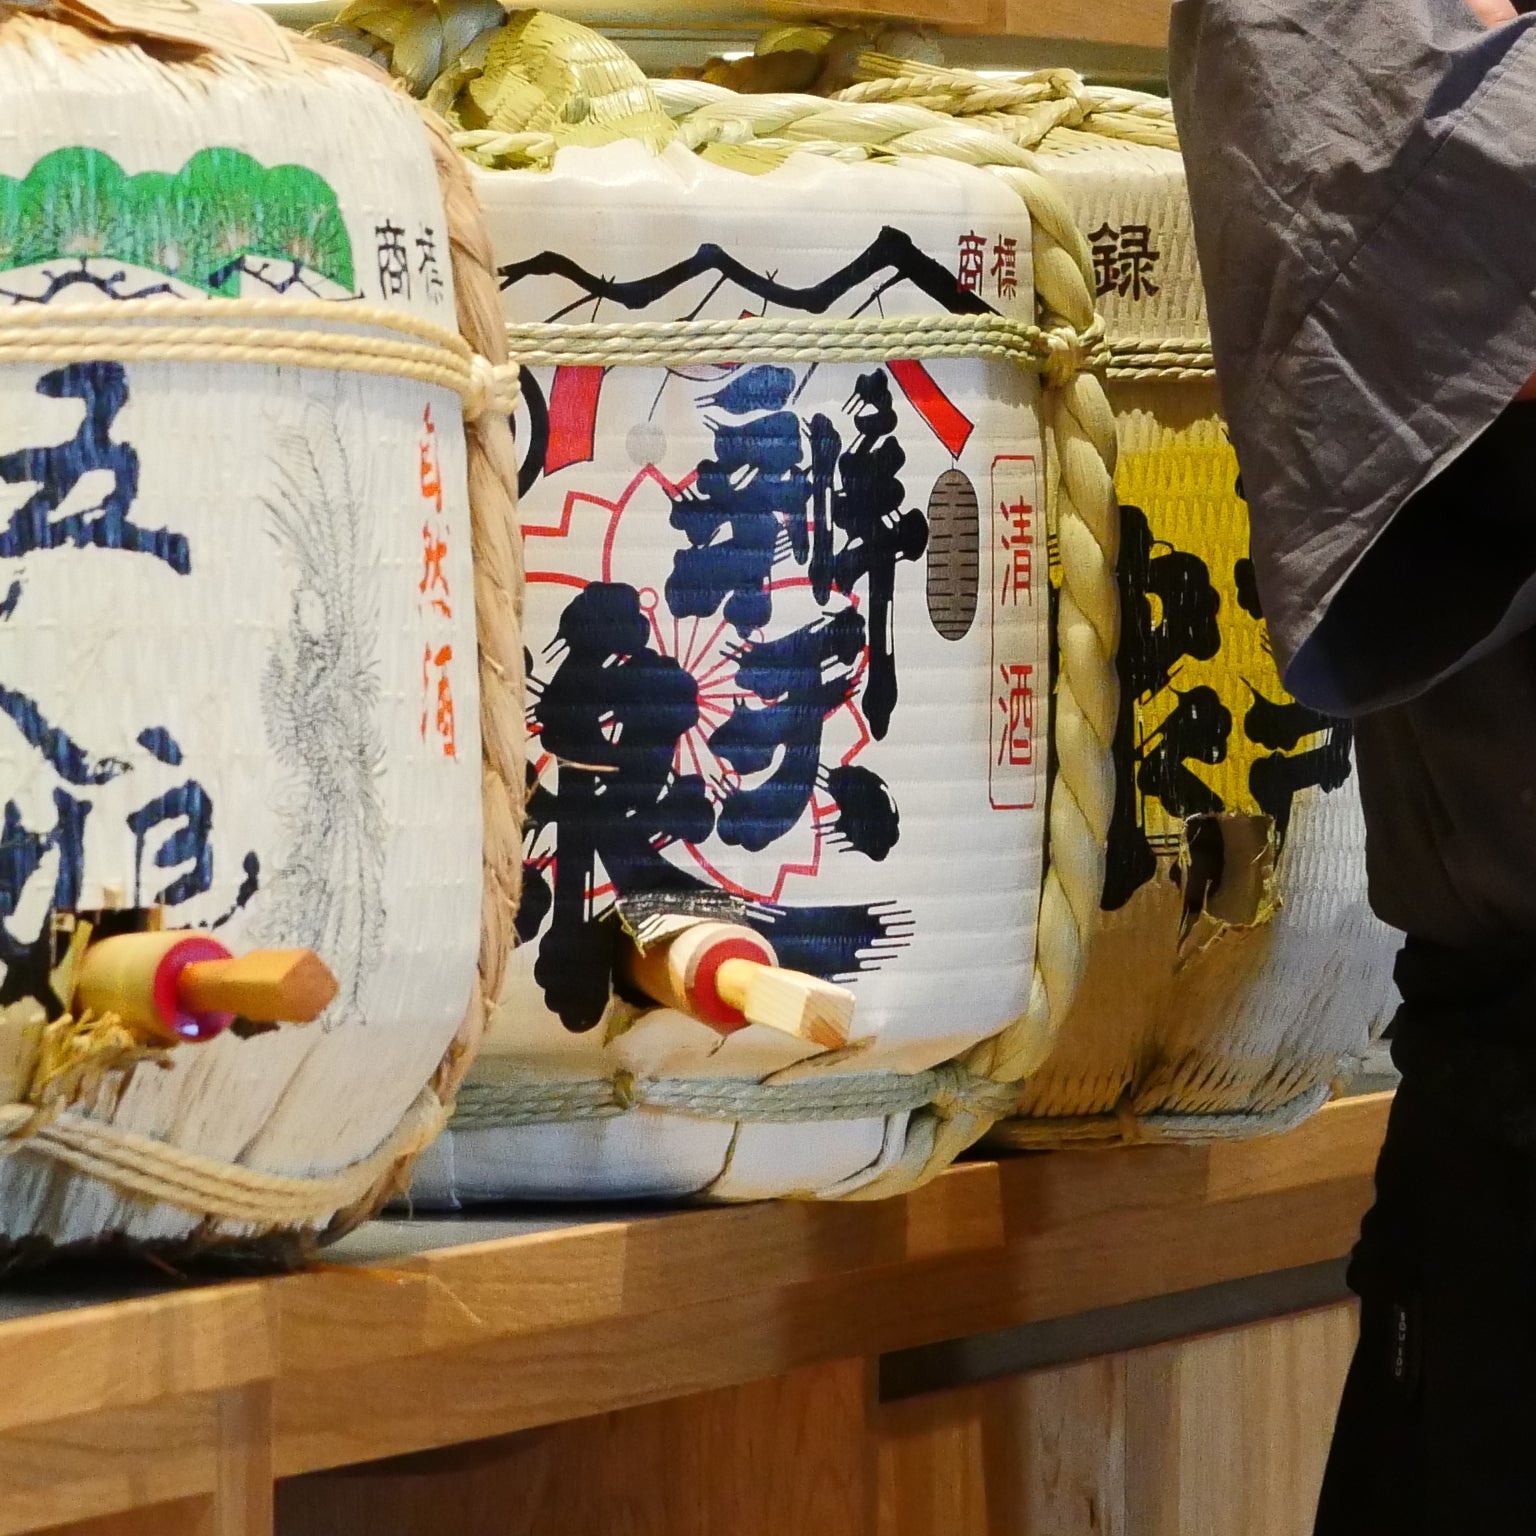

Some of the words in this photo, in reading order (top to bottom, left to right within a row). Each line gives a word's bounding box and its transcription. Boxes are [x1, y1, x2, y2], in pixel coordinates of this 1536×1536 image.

[956, 229, 1019, 300] 商標
[1087, 221, 1161, 302] 録
[996, 494, 1035, 768] 清酒
